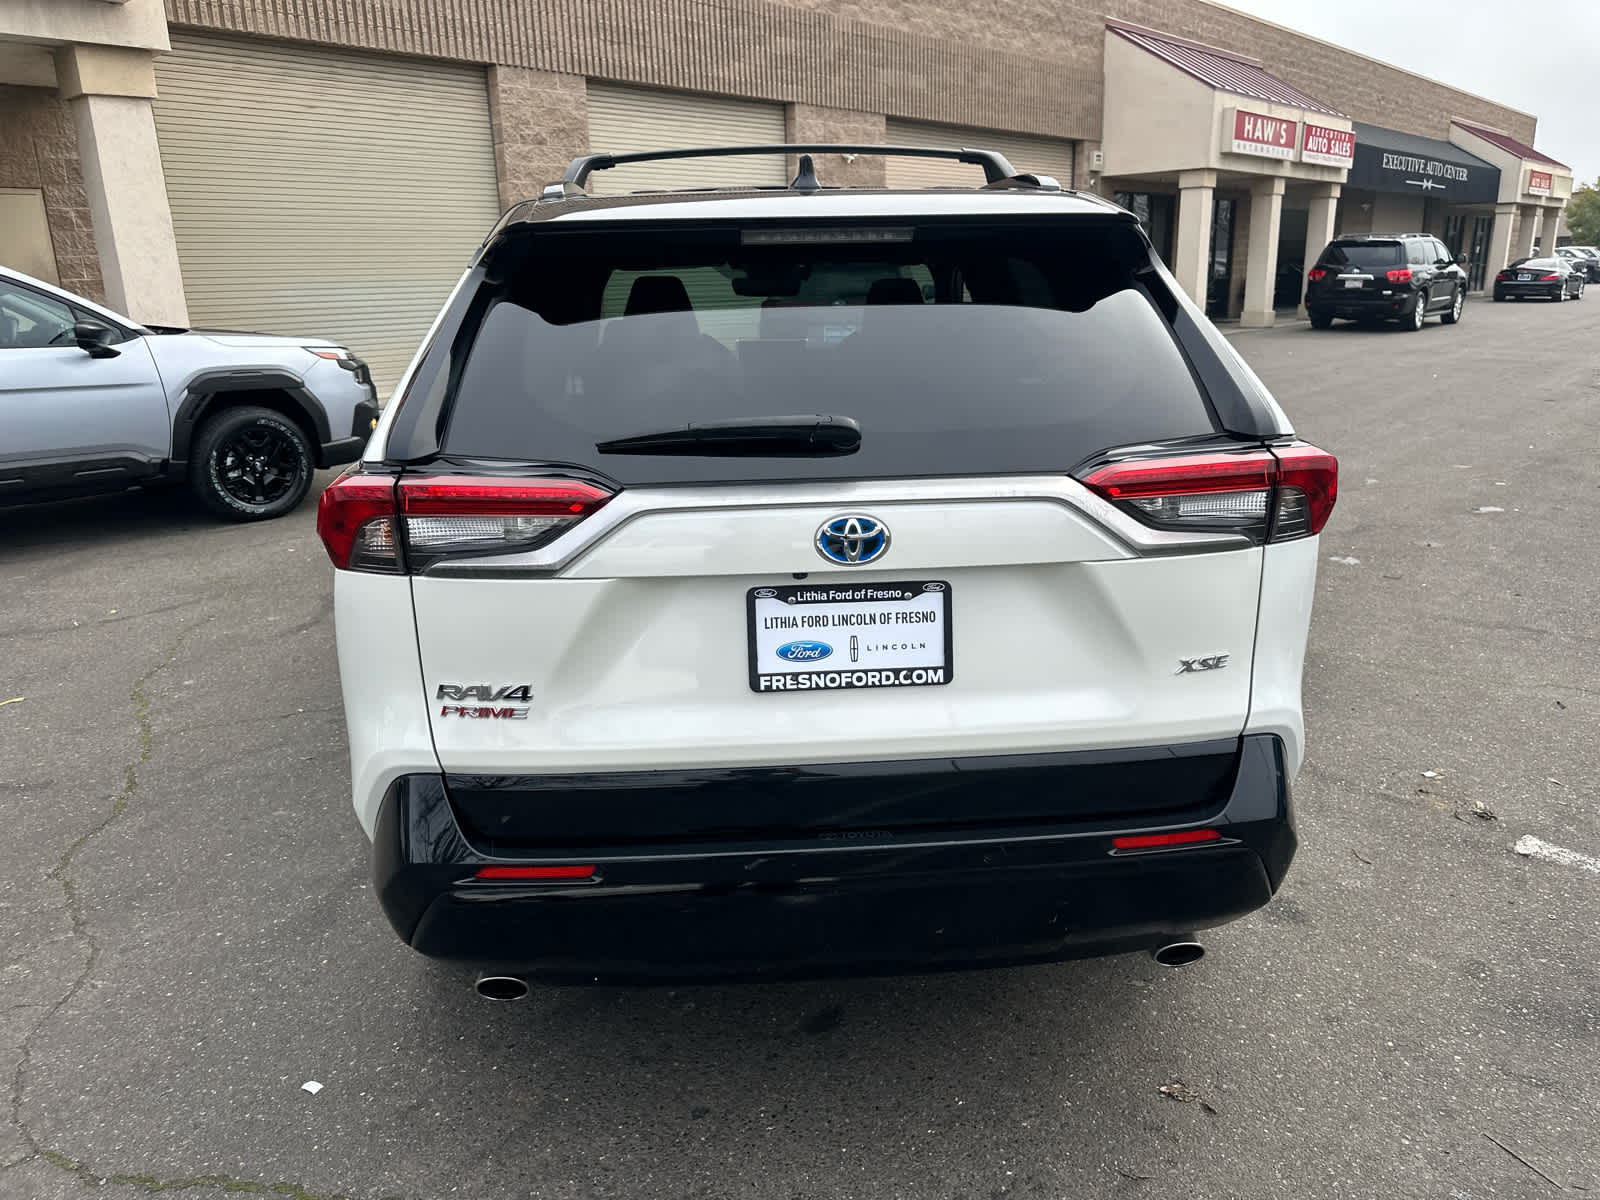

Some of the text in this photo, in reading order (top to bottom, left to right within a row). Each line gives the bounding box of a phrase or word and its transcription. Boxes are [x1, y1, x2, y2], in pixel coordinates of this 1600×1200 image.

[1243, 116, 1287, 145] HAW'S
[1312, 127, 1349, 142] EXECUTIVE
[1307, 135, 1351, 156] AUTO SALES
[1382, 153, 1468, 182] EXECUTIVE AUTO CENTER
[797, 588, 902, 601] Lithia Ford of Fresno
[764, 610, 936, 630] LITHIA FORD LINCOLN OF FRESNO
[787, 643, 821, 658] Ford
[866, 642, 926, 651] LINCOLN
[1174, 654, 1230, 675] XSE
[759, 669, 944, 691] FRESNOFORD.COM
[436, 684, 534, 703] RAV4
[440, 705, 530, 720] PRIME
